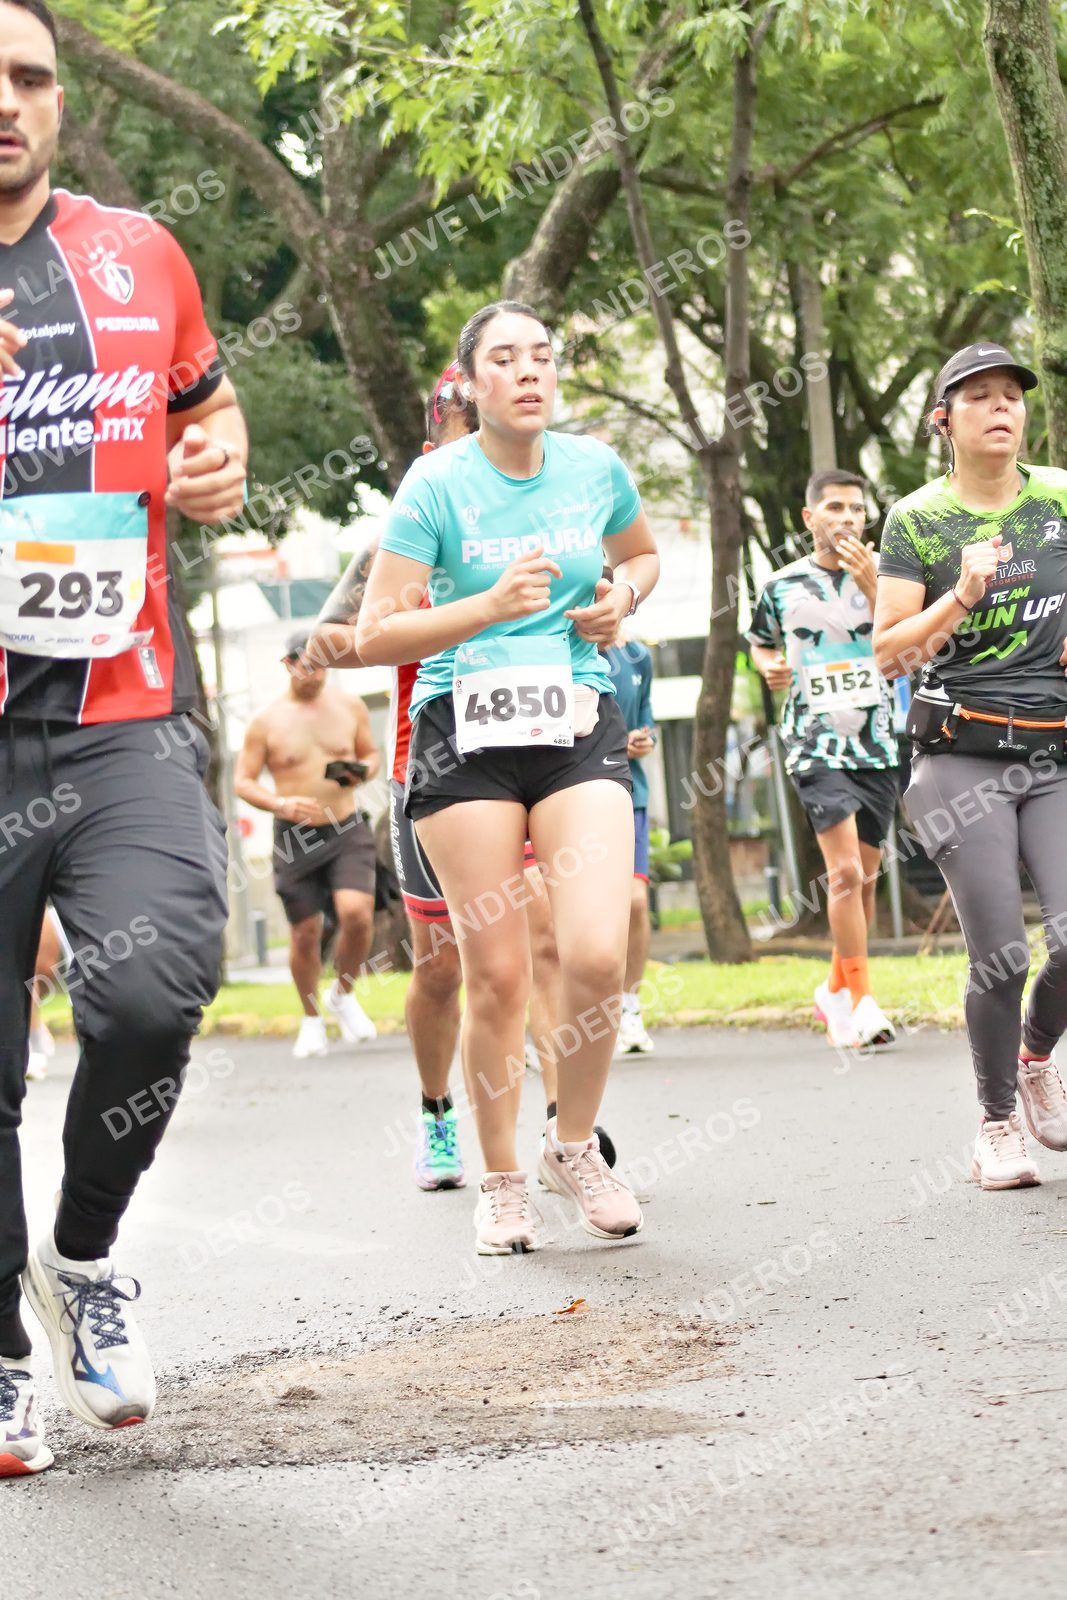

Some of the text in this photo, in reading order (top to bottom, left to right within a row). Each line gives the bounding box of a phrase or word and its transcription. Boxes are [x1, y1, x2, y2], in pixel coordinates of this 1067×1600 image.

[95, 317, 160, 332] PERDURA
[0, 364, 155, 422] aliente
[461, 524, 598, 564] PERDURA
[991, 559, 1037, 581] TAR
[18, 570, 124, 619] 293
[991, 586, 1031, 605] TEAM
[1023, 592, 1066, 622] UP!
[810, 670, 873, 696] 5152
[465, 685, 567, 726] 4850
